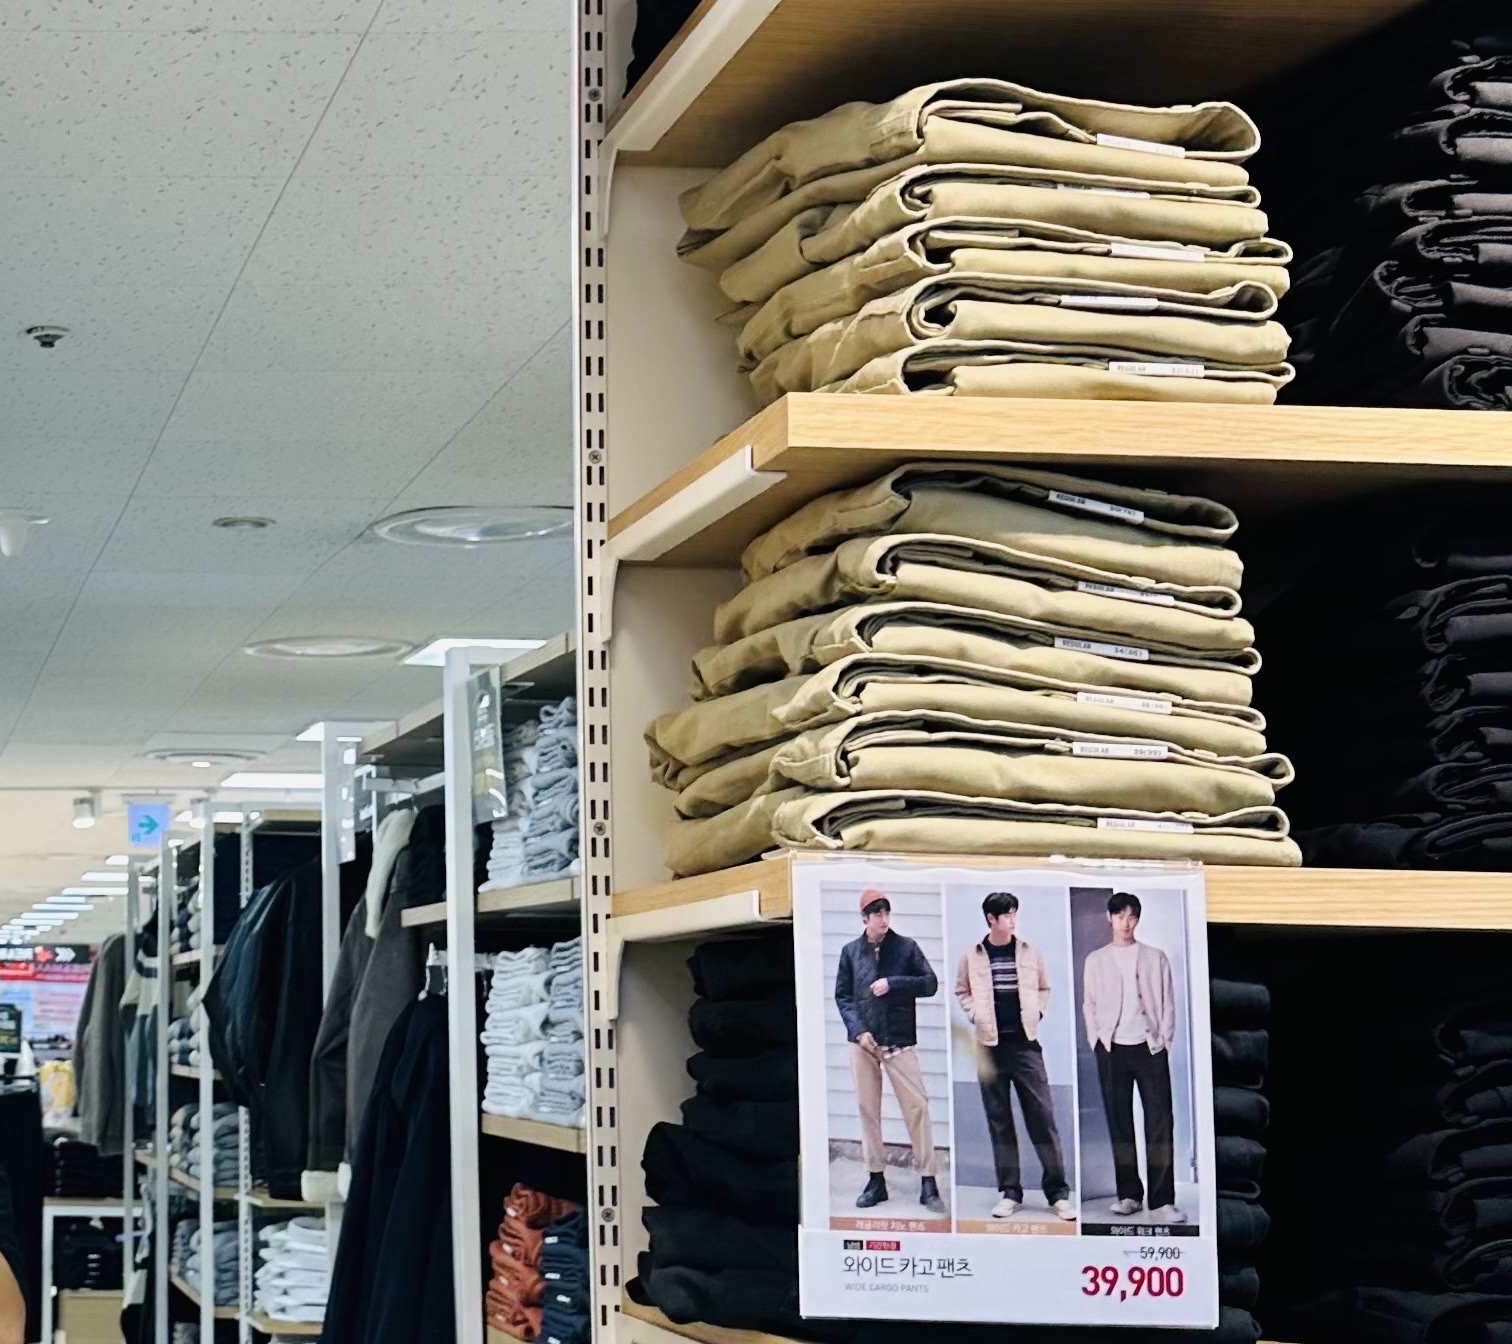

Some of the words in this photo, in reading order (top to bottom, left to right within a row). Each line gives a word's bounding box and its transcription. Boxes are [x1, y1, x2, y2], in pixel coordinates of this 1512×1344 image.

[1140, 1246, 1181, 1261] 59,900
[843, 1256, 898, 1277] 와이드
[899, 1257, 936, 1278] 카고
[937, 1257, 974, 1279] 팬츠
[845, 1282, 866, 1292] WIDE
[869, 1283, 899, 1293] CARGO
[900, 1283, 929, 1294] PANTS
[1081, 1265, 1184, 1303] 39,900
